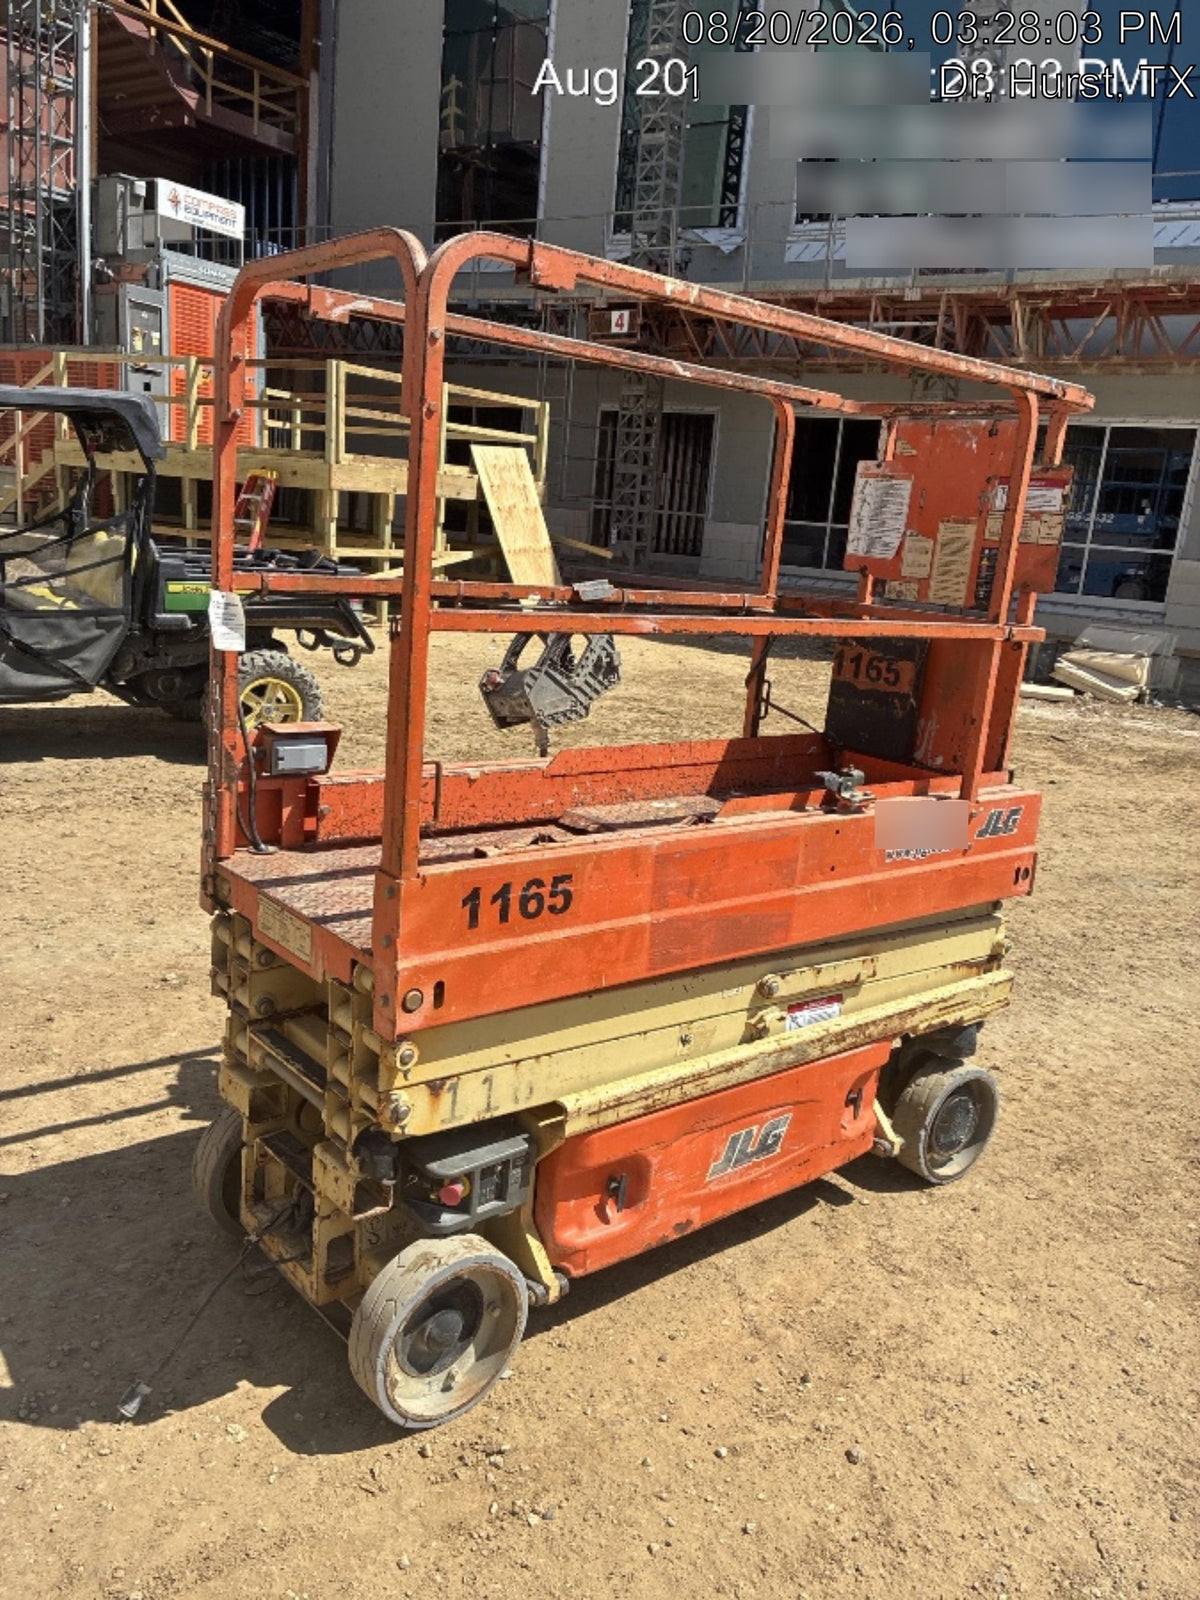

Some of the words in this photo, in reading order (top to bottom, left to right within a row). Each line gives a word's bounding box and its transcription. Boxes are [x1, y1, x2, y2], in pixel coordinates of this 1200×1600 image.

[614, 311, 625, 331] 4
[834, 649, 901, 686] 1165
[974, 805, 1025, 840] JLG
[461, 873, 574, 931] 1165
[704, 1112, 793, 1182] JLG
